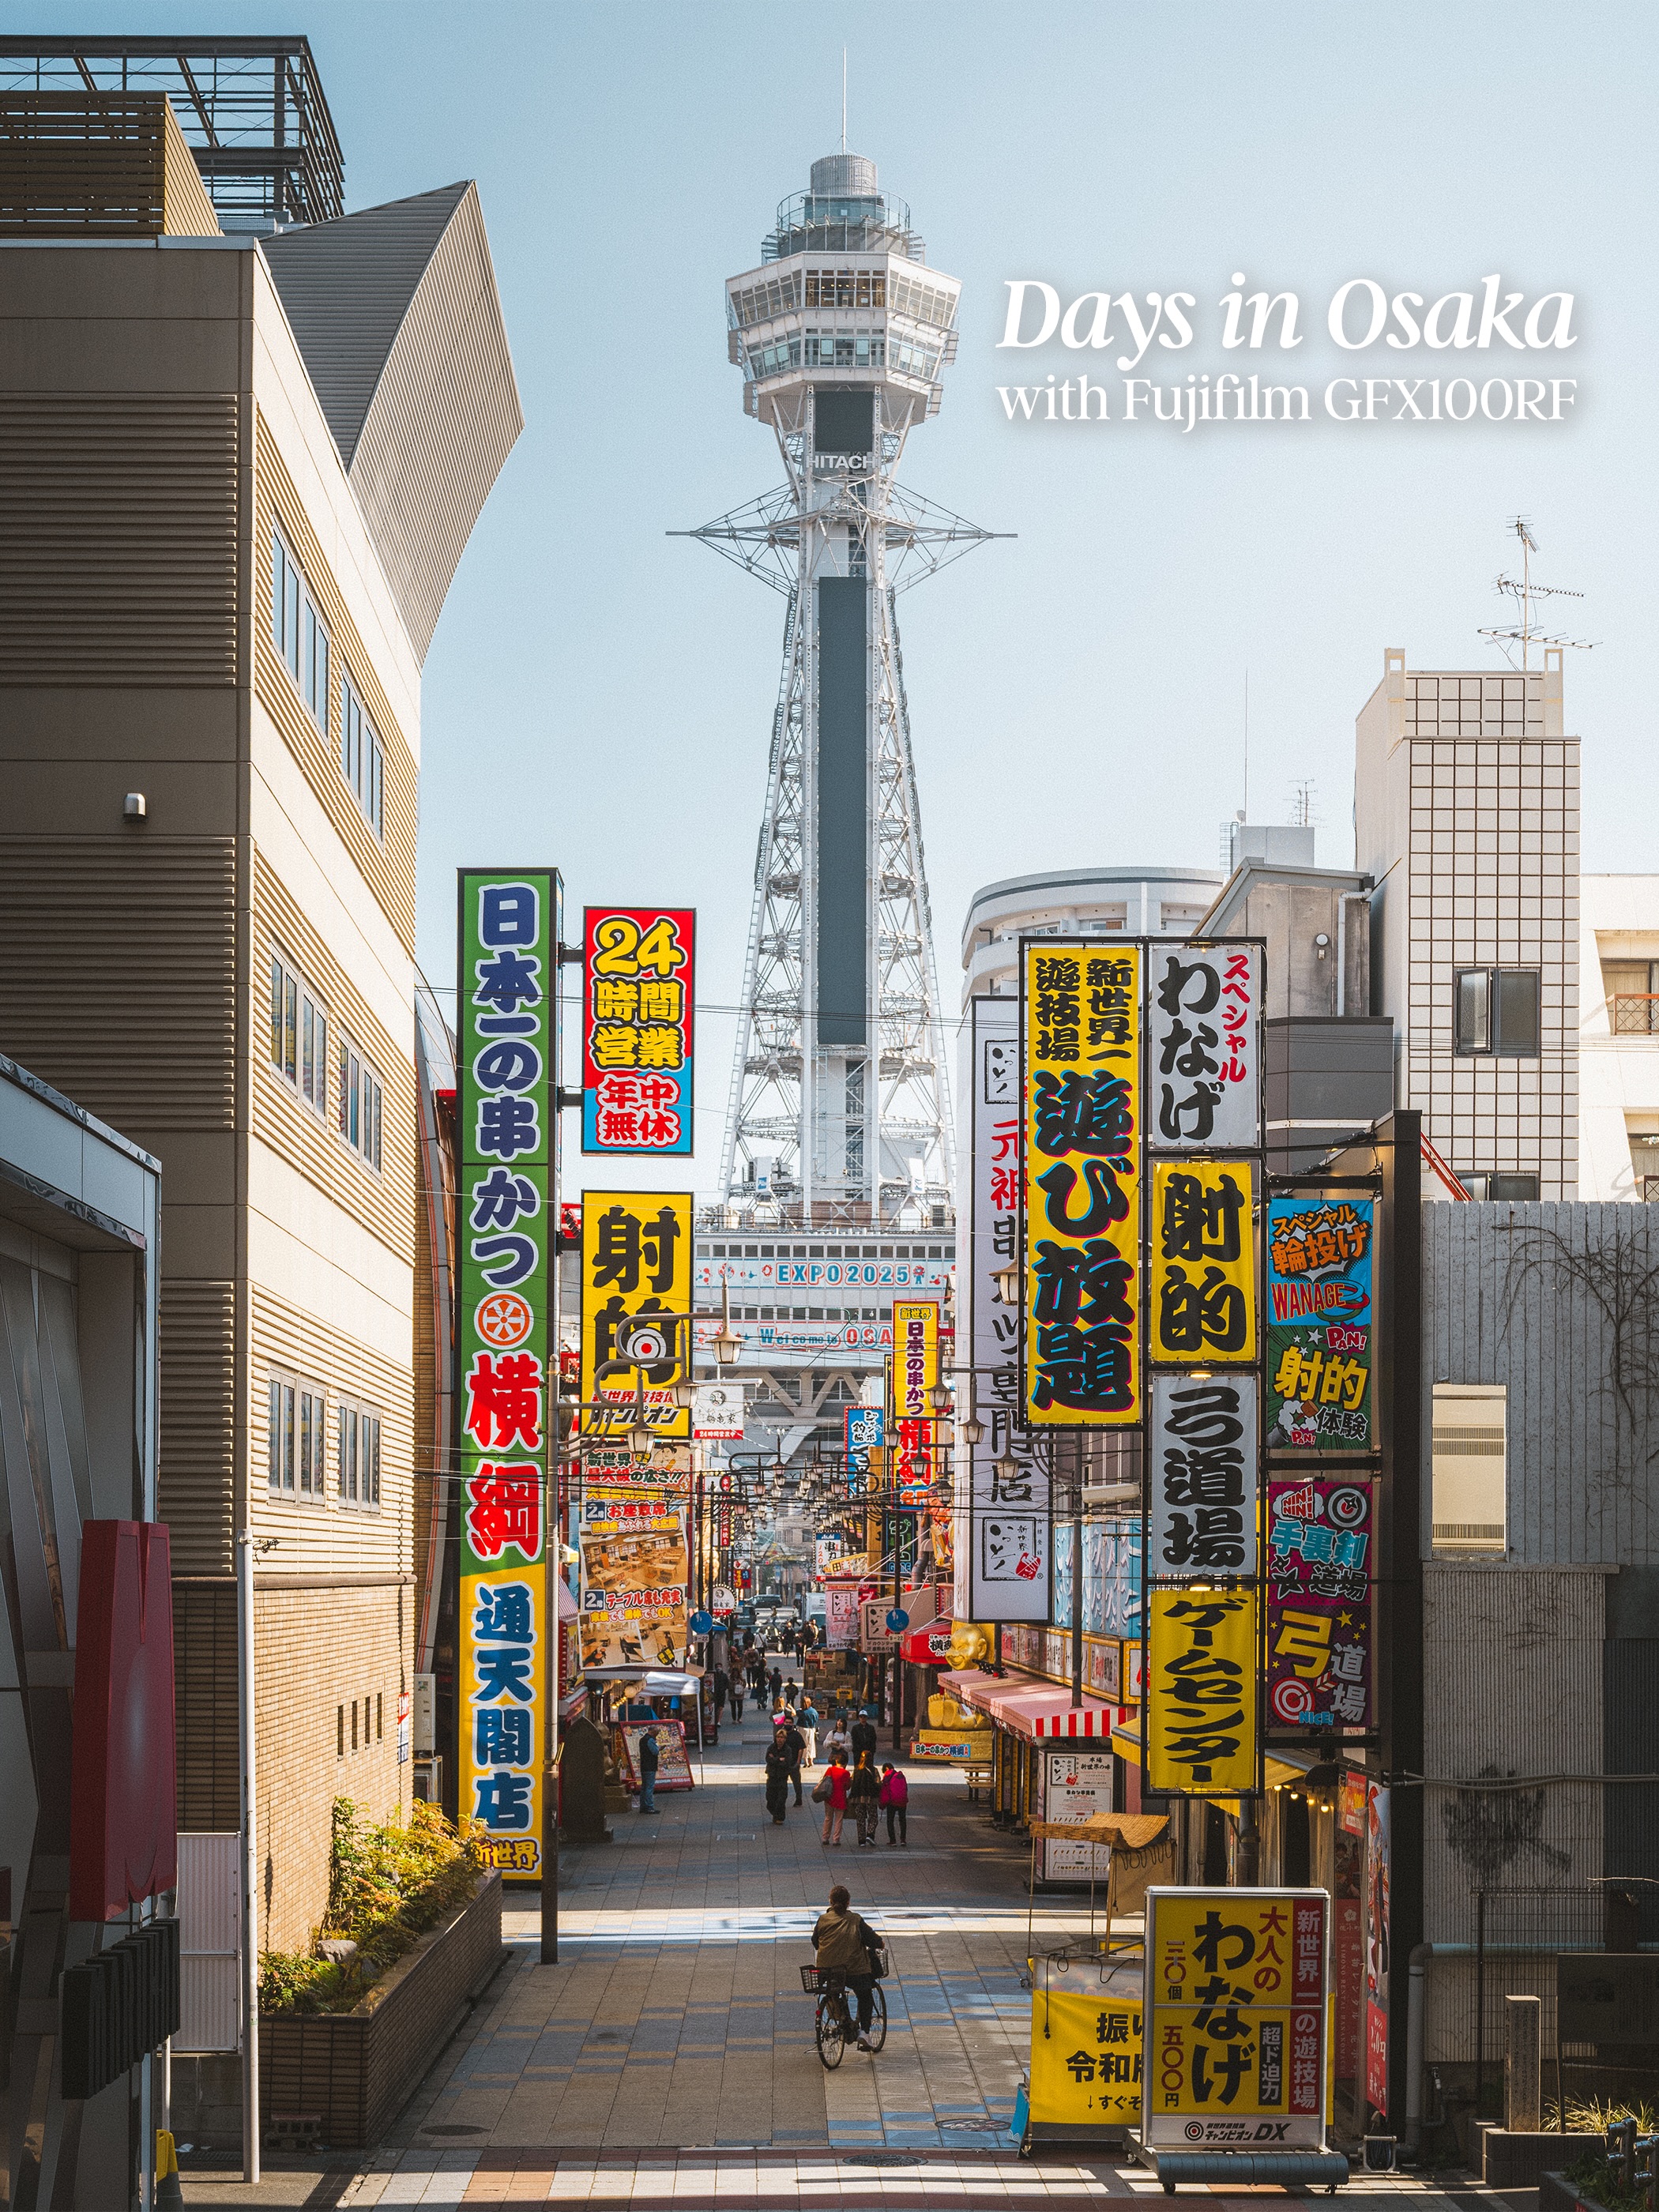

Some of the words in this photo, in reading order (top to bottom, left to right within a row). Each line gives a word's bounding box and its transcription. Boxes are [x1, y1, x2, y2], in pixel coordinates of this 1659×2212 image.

[806, 455, 878, 469] HITACH
[596, 919, 684, 977] 24
[594, 980, 682, 1023] 時間
[1086, 957, 1134, 1061] 新世界一
[1217, 954, 1251, 1083] スペシャル
[594, 1026, 681, 1068] 営業
[1157, 956, 1226, 1140] わなげ
[473, 883, 540, 1287] 日本一の串かつ
[603, 1078, 675, 1109] 年中
[602, 1112, 675, 1142] 無休
[1031, 1069, 1136, 1412] 遊び放題
[1273, 1203, 1356, 1237] スペシャル
[777, 1262, 841, 1285] EXPO
[845, 1262, 909, 1285] 2025
[1160, 1172, 1247, 1352] 射的
[1270, 1223, 1370, 1275] 輪投げ
[592, 1205, 681, 1385] 射的
[901, 1307, 931, 1320] 新世界
[991, 1119, 1033, 1501] 元祖串ツ専門店
[1270, 1282, 1346, 1322] WANAGE
[760, 1327, 824, 1345] Welcome
[1326, 1326, 1367, 1351] PAN!
[906, 1322, 924, 1416] 日本一の串かつ
[1273, 1345, 1368, 1412] 射的
[1290, 1429, 1316, 1446] PAN!
[1316, 1406, 1368, 1441] 体験
[466, 1352, 542, 1559] 横綱
[586, 1452, 632, 1467] 新世界
[1163, 1386, 1246, 1567] 弓道場
[1282, 1484, 1313, 1507] NIN!
[1282, 1502, 1313, 1519] NIN!
[1270, 1519, 1369, 1571] 手裏剣
[1309, 1565, 1368, 1602] 道場
[1159, 1597, 1248, 1782] ゲームセンター
[1273, 1609, 1333, 1679] 弓
[1330, 1642, 1367, 1722] 道場
[472, 1582, 536, 1832] 通天閣店
[1299, 1711, 1334, 1726] NICE!
[1254, 1905, 1288, 1992] 大人の
[1191, 1911, 1256, 2106] わなげ
[1292, 1909, 1320, 2109] 新世界一の遊技場
[1262, 2026, 1282, 2101] 超ド迫力
[1253, 2123, 1292, 2141] DX
